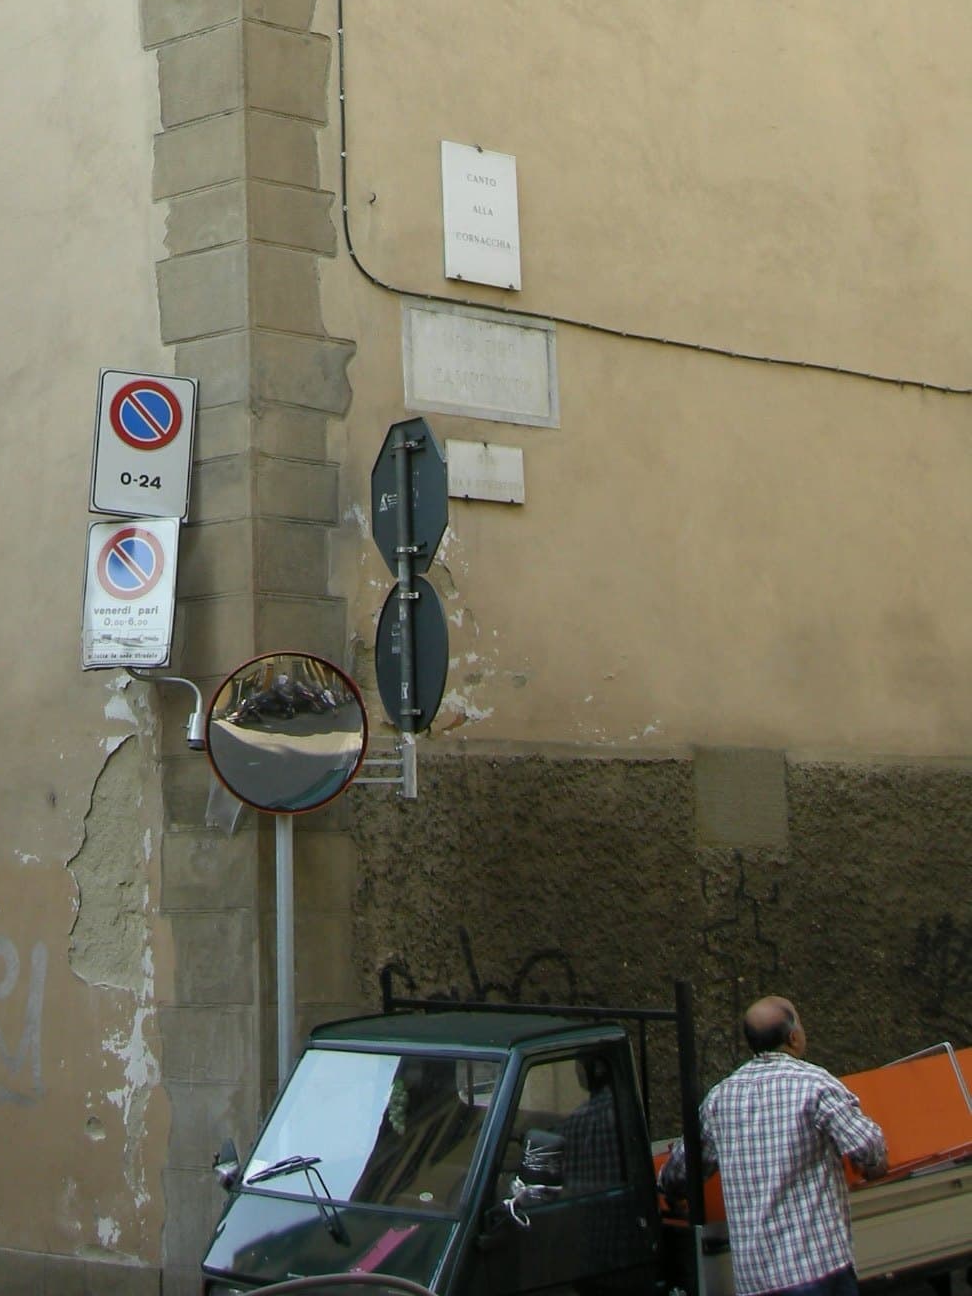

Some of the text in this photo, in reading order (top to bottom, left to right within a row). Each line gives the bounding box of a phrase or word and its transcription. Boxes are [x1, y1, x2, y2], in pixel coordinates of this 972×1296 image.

[466, 173, 496, 187] CANTO
[472, 205, 494, 217] ALLA
[120, 471, 162, 489] 0-24
[137, 605, 159, 616] pari
